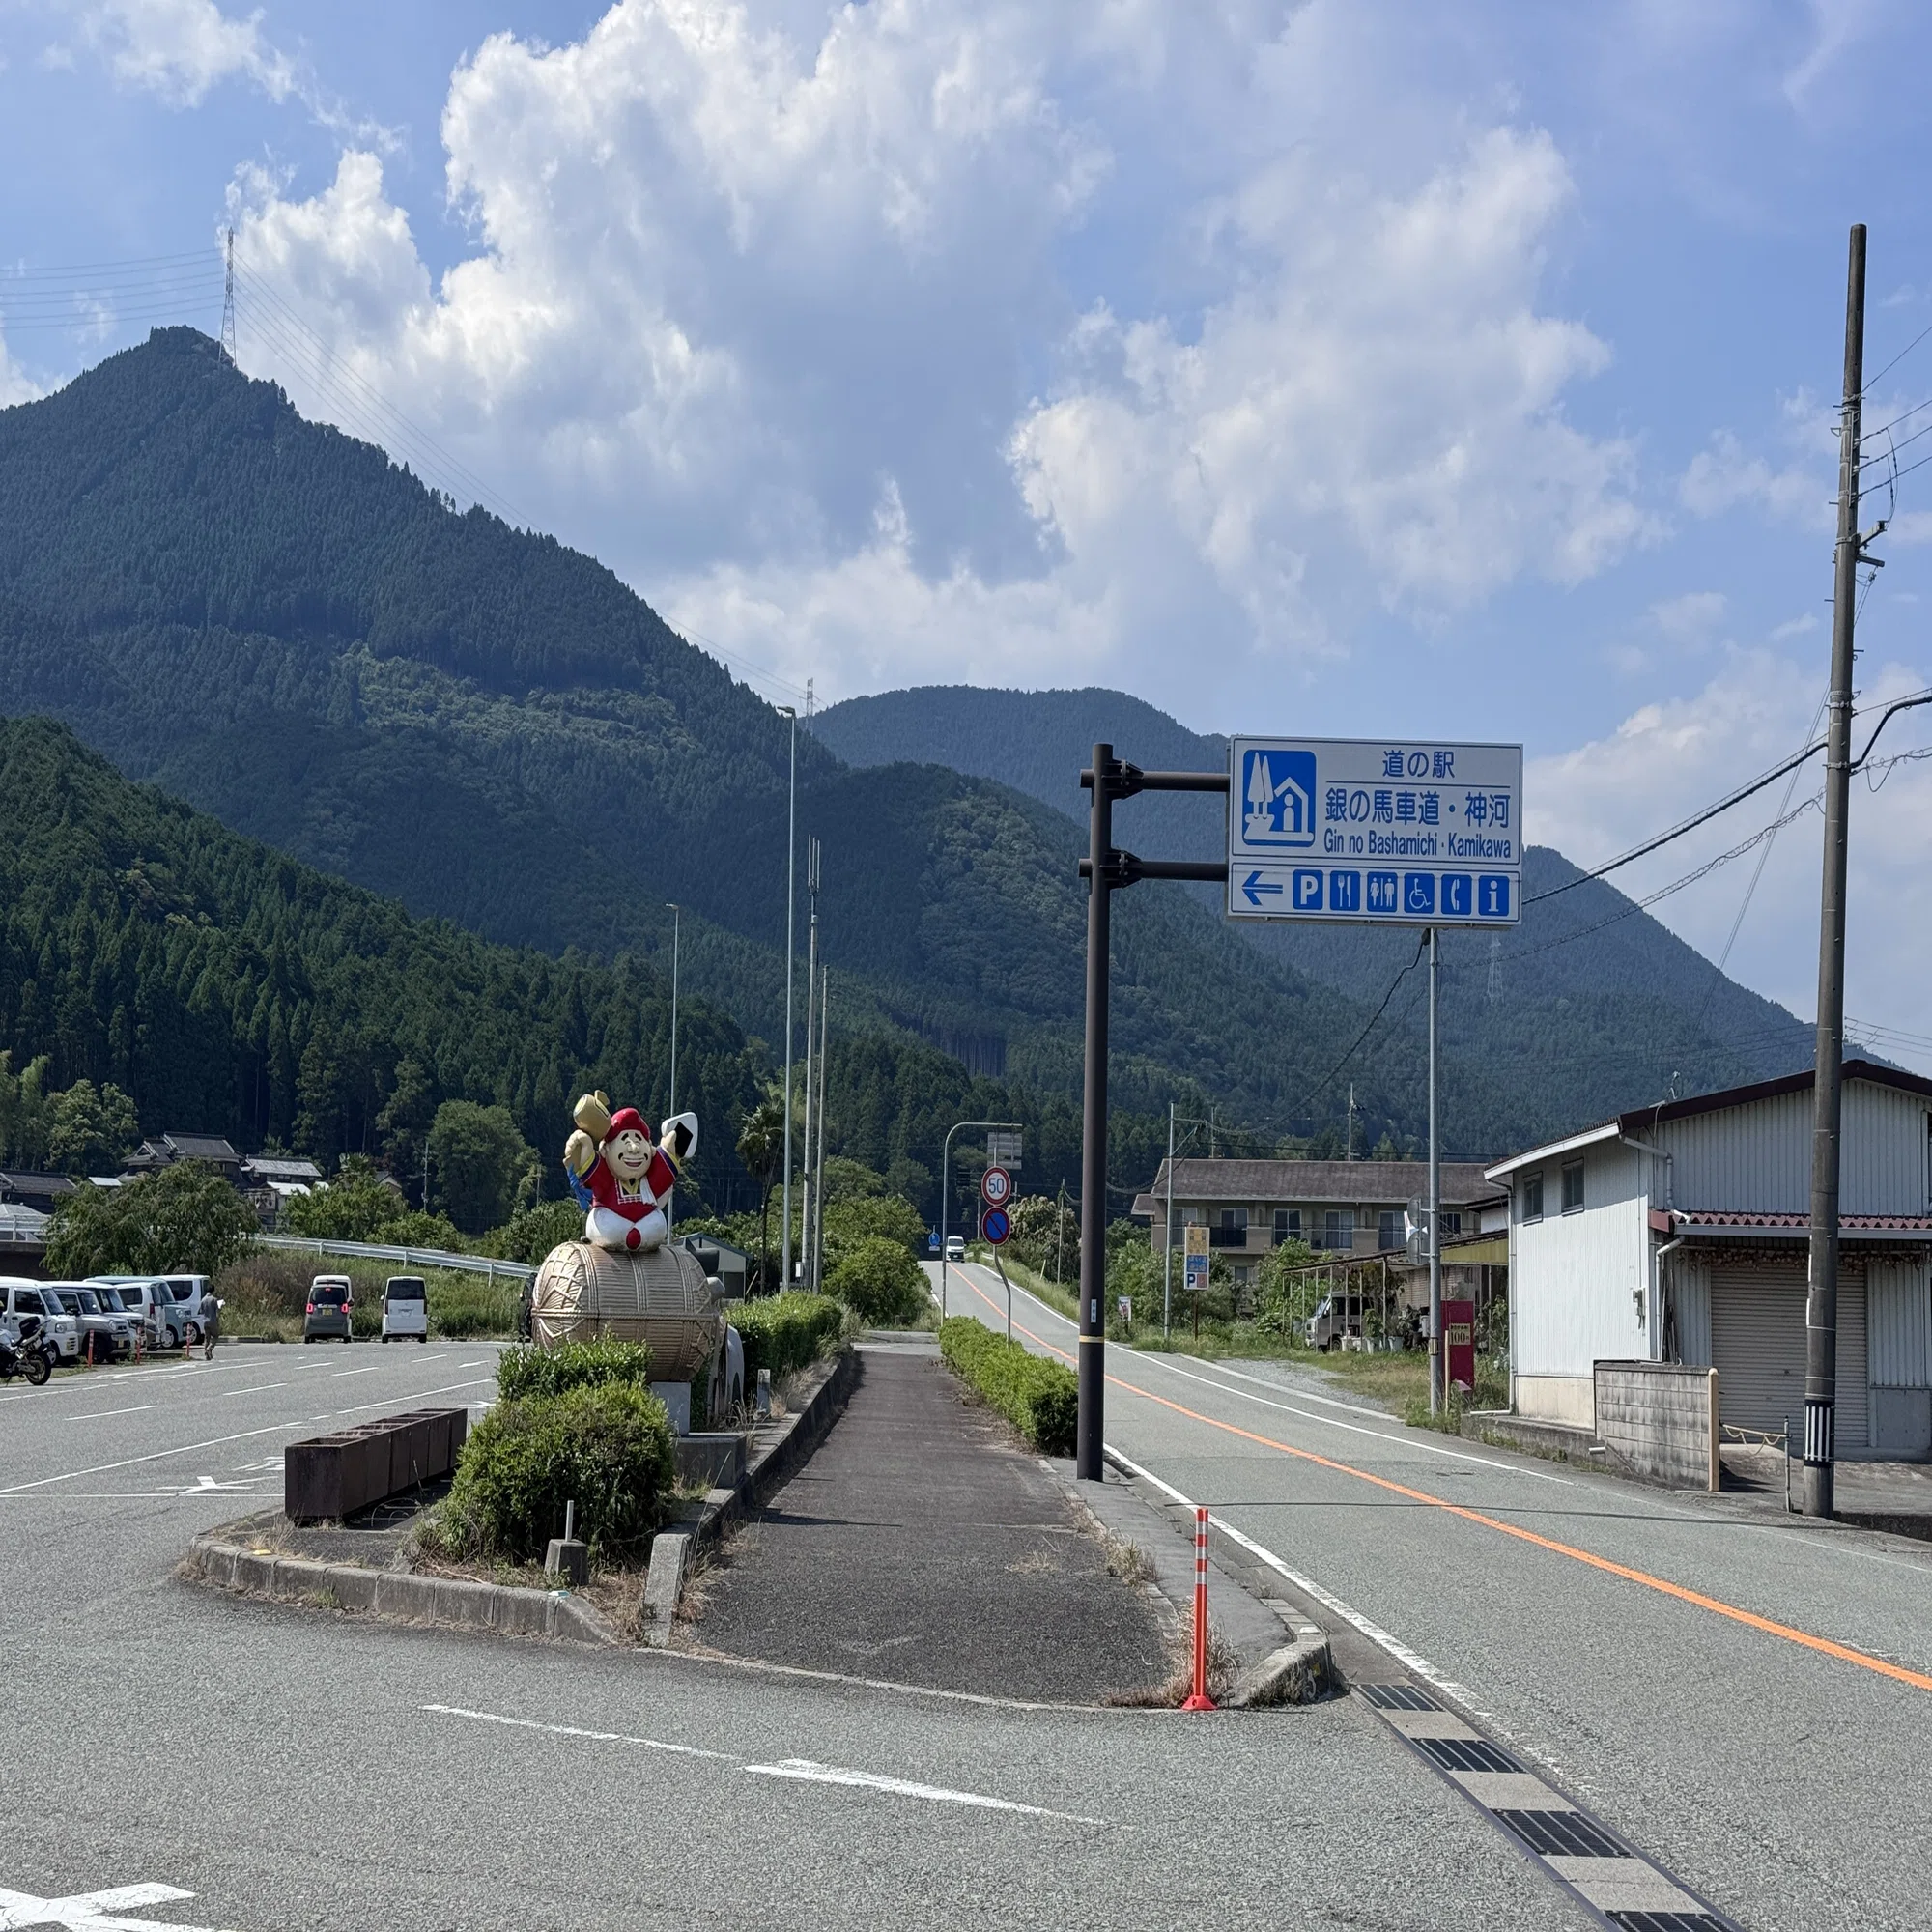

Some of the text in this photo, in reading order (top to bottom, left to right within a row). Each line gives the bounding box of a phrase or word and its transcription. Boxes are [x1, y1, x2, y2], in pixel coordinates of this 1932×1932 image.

[1382, 750, 1455, 779] 道の駅
[1325, 787, 1511, 828] 銀の馬車道・神河
[1323, 827, 1344, 853] Gin
[1349, 835, 1363, 854] no
[1368, 830, 1437, 857] Bashamichi
[1448, 832, 1511, 859] Kamikawa
[1300, 875, 1318, 905] P
[988, 1178, 1005, 1194] 50
